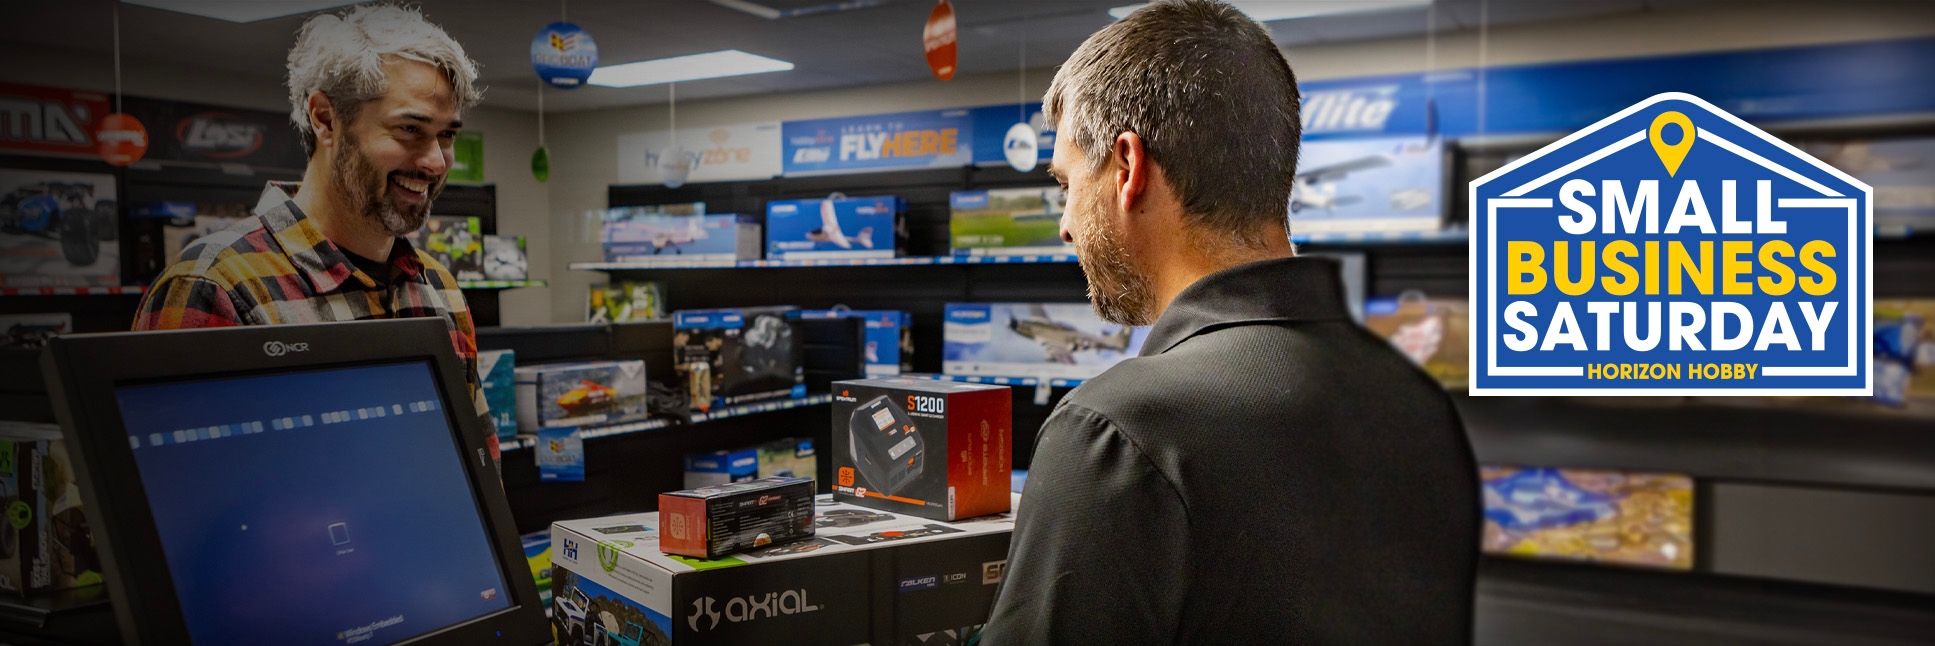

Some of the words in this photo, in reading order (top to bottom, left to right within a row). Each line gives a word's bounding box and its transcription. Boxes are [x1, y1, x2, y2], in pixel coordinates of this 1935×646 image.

[285, 342, 310, 352] NCR
[908, 395, 944, 414] S1200
[901, 577, 936, 587] FALKEN
